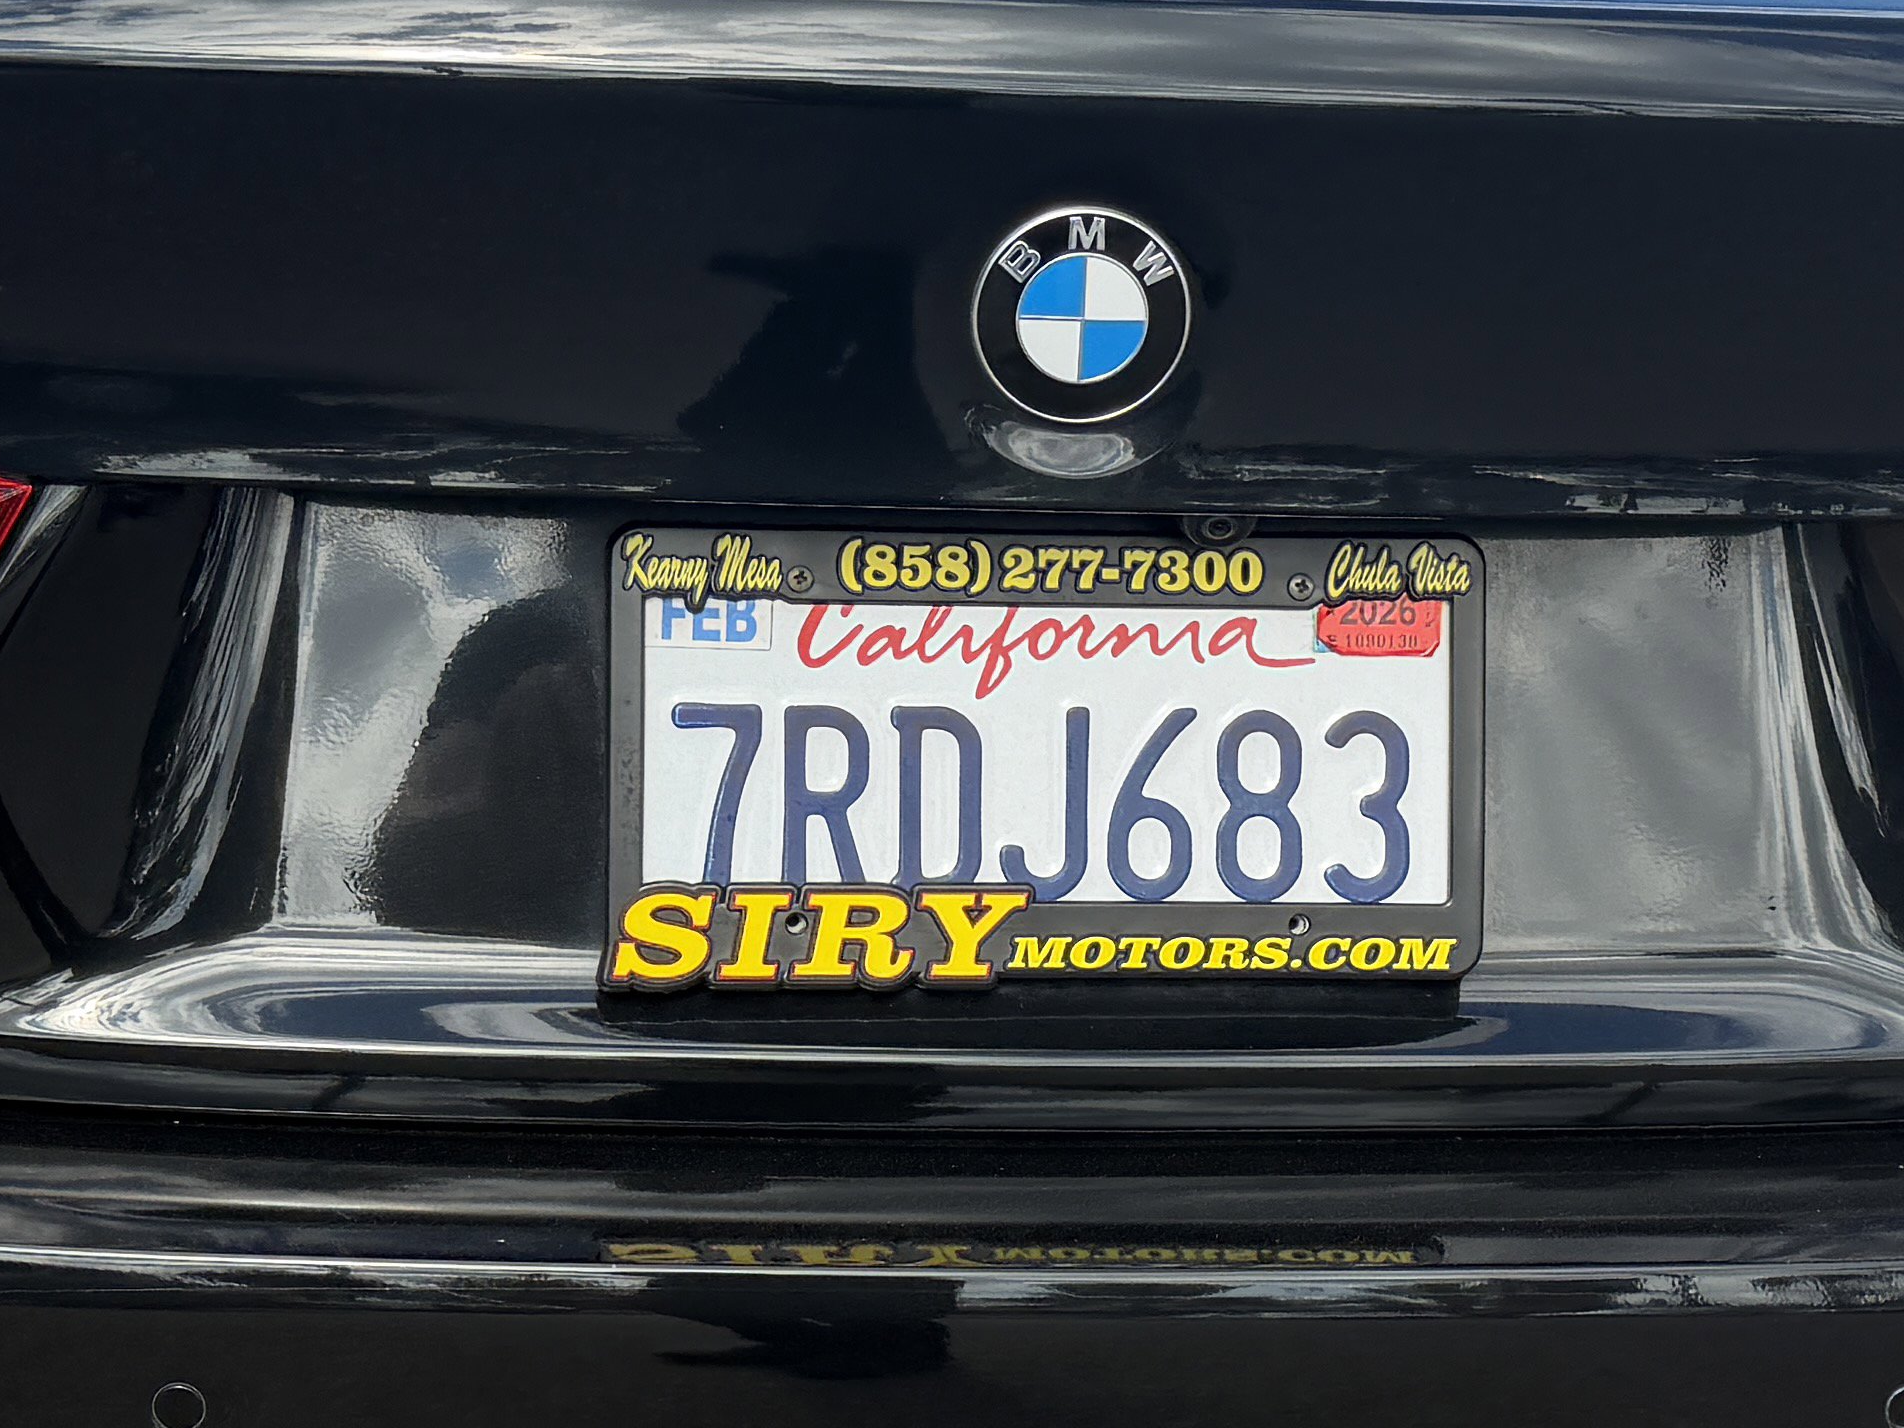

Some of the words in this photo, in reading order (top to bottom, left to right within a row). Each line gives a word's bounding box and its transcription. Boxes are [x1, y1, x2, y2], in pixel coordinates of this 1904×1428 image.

[998, 216, 1174, 285] BMW
[623, 534, 707, 606] Kearny
[713, 534, 783, 593] Mesa
[841, 538, 991, 595] (858)
[1002, 544, 1263, 594] 277-7300
[1328, 543, 1401, 599] Chula
[1409, 541, 1471, 593] Vista
[661, 598, 757, 643] FEB
[1340, 600, 1416, 625] 2026
[797, 604, 1318, 699] California
[671, 703, 1412, 905] 7RDJ683
[613, 891, 1029, 981] SIRY
[1007, 936, 1458, 971] MOTORS.COM
